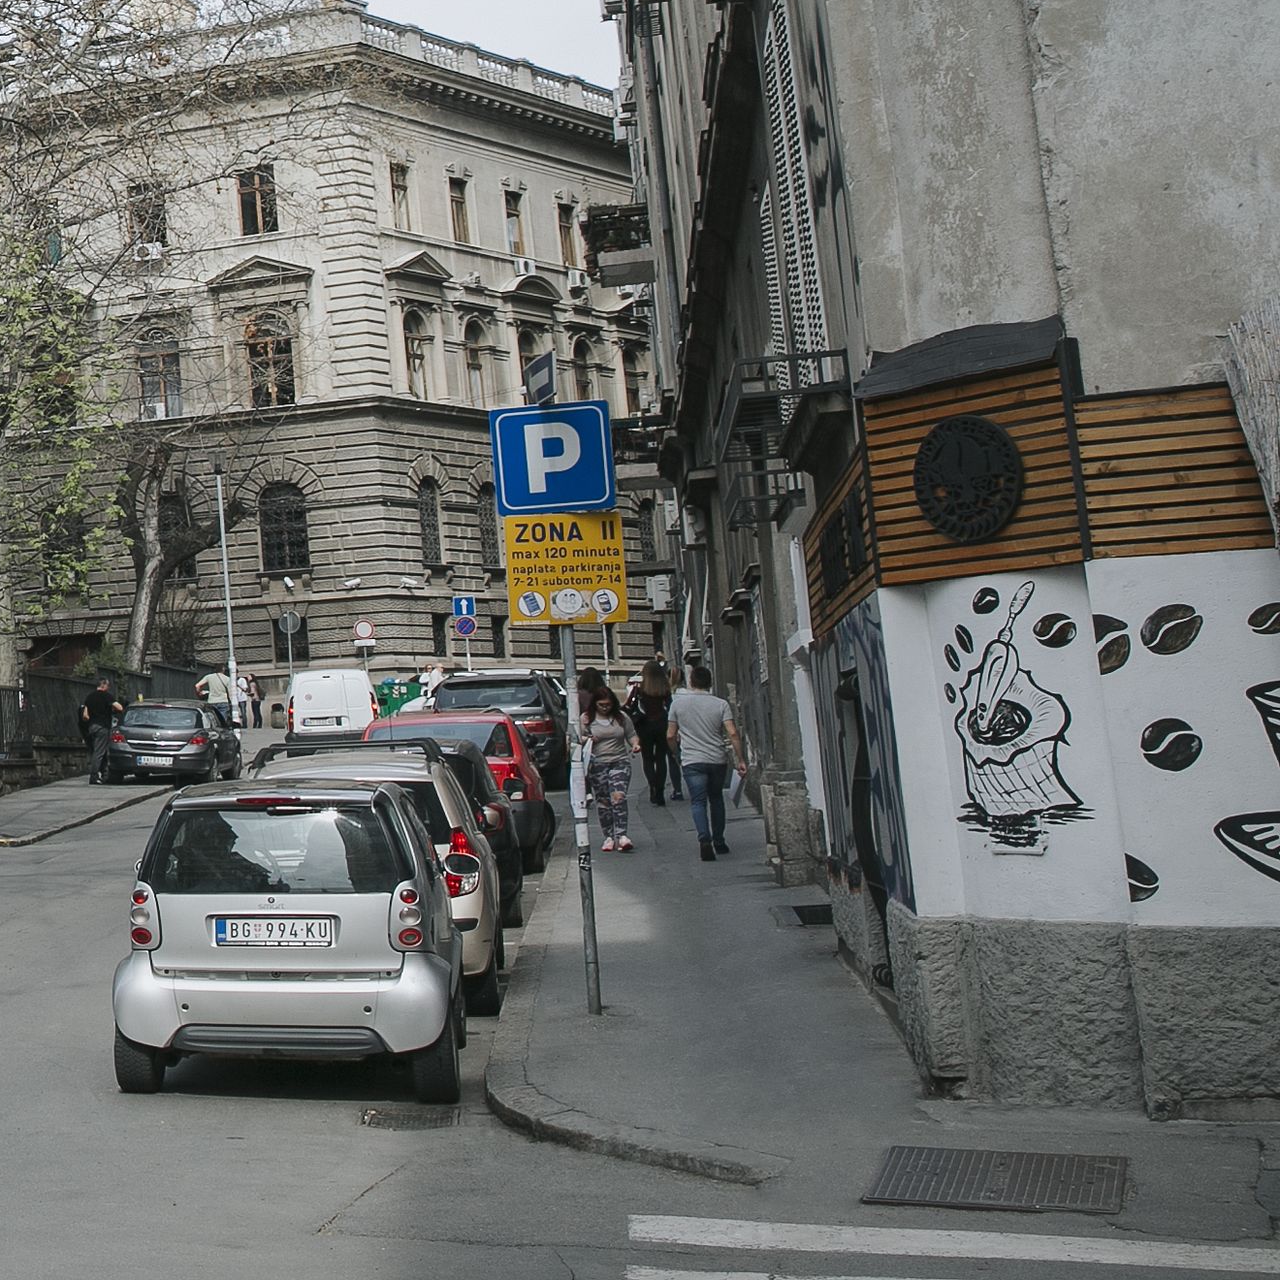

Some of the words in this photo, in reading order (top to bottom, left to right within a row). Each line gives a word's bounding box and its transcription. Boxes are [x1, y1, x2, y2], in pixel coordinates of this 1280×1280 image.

[523, 422, 581, 494] P
[514, 521, 584, 543] ZONA
[601, 520, 615, 540] II
[512, 549, 540, 559] max
[545, 547, 567, 558] 120
[572, 546, 620, 558] minuta
[561, 562, 621, 575] parkiranja
[513, 577, 539, 587] 7-21
[542, 575, 593, 586] subotom
[596, 574, 622, 584] 7-14
[230, 922, 251, 938] BG
